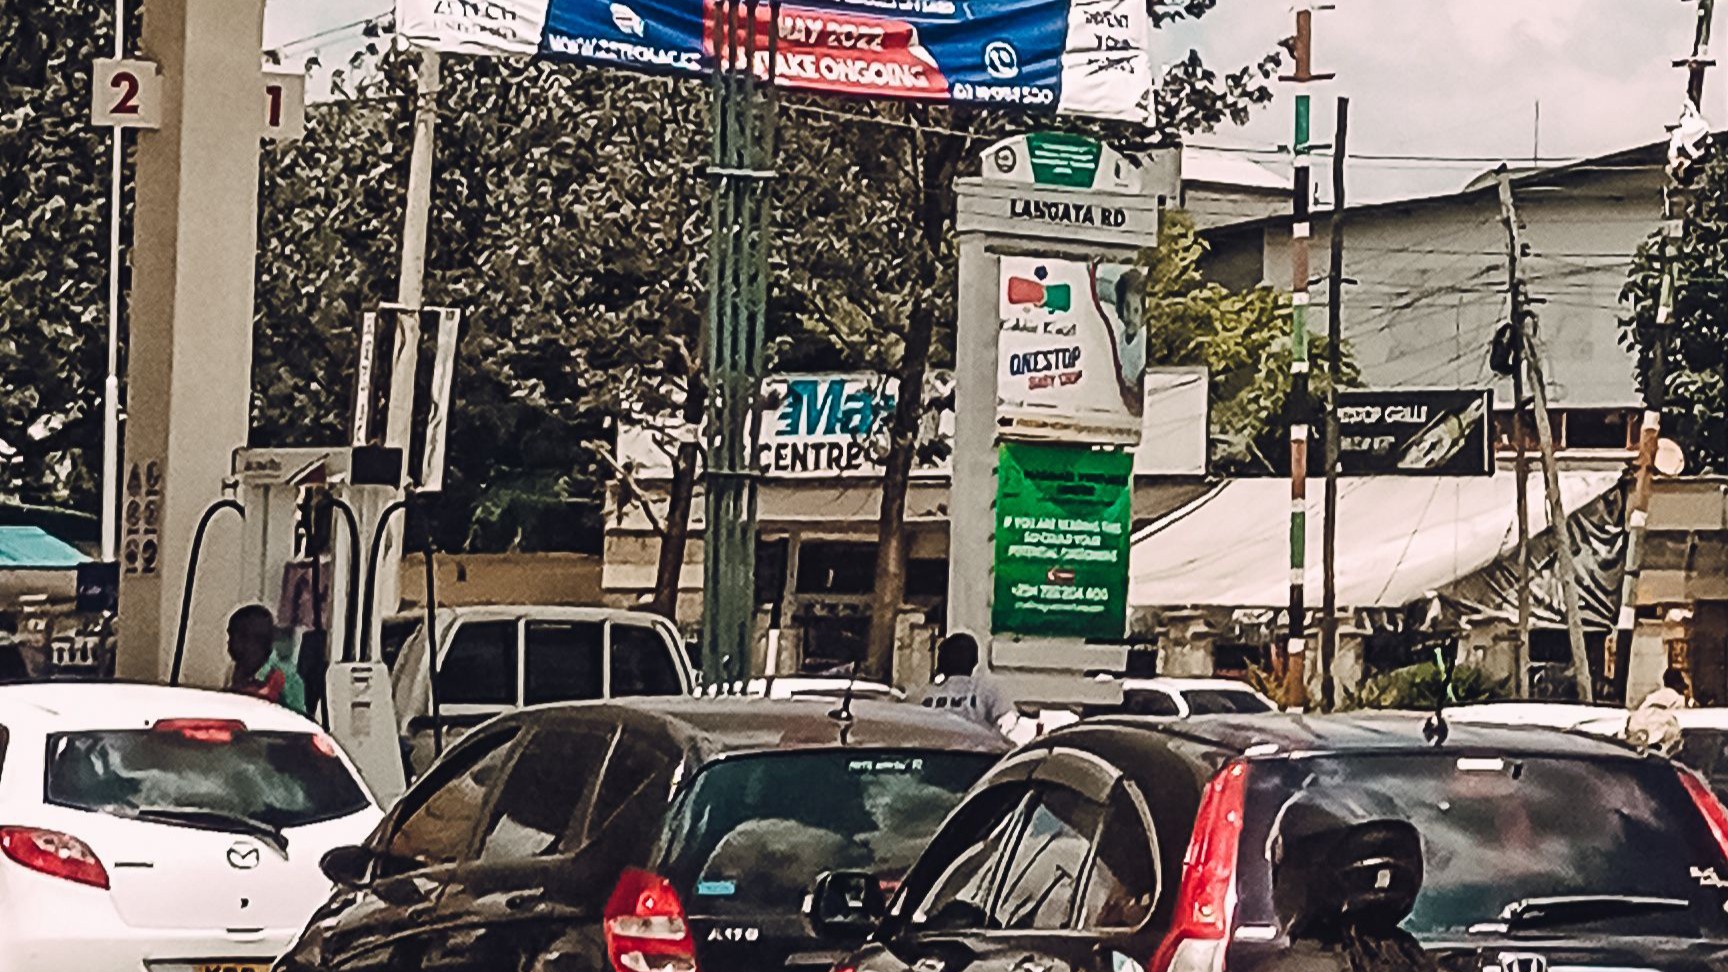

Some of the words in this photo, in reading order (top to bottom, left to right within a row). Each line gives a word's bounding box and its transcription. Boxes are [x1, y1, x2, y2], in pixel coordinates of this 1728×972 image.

[819, 56, 930, 88] ONGOING
[109, 71, 140, 115] 2
[265, 84, 283, 127] 1
[1100, 207, 1126, 228] RD
